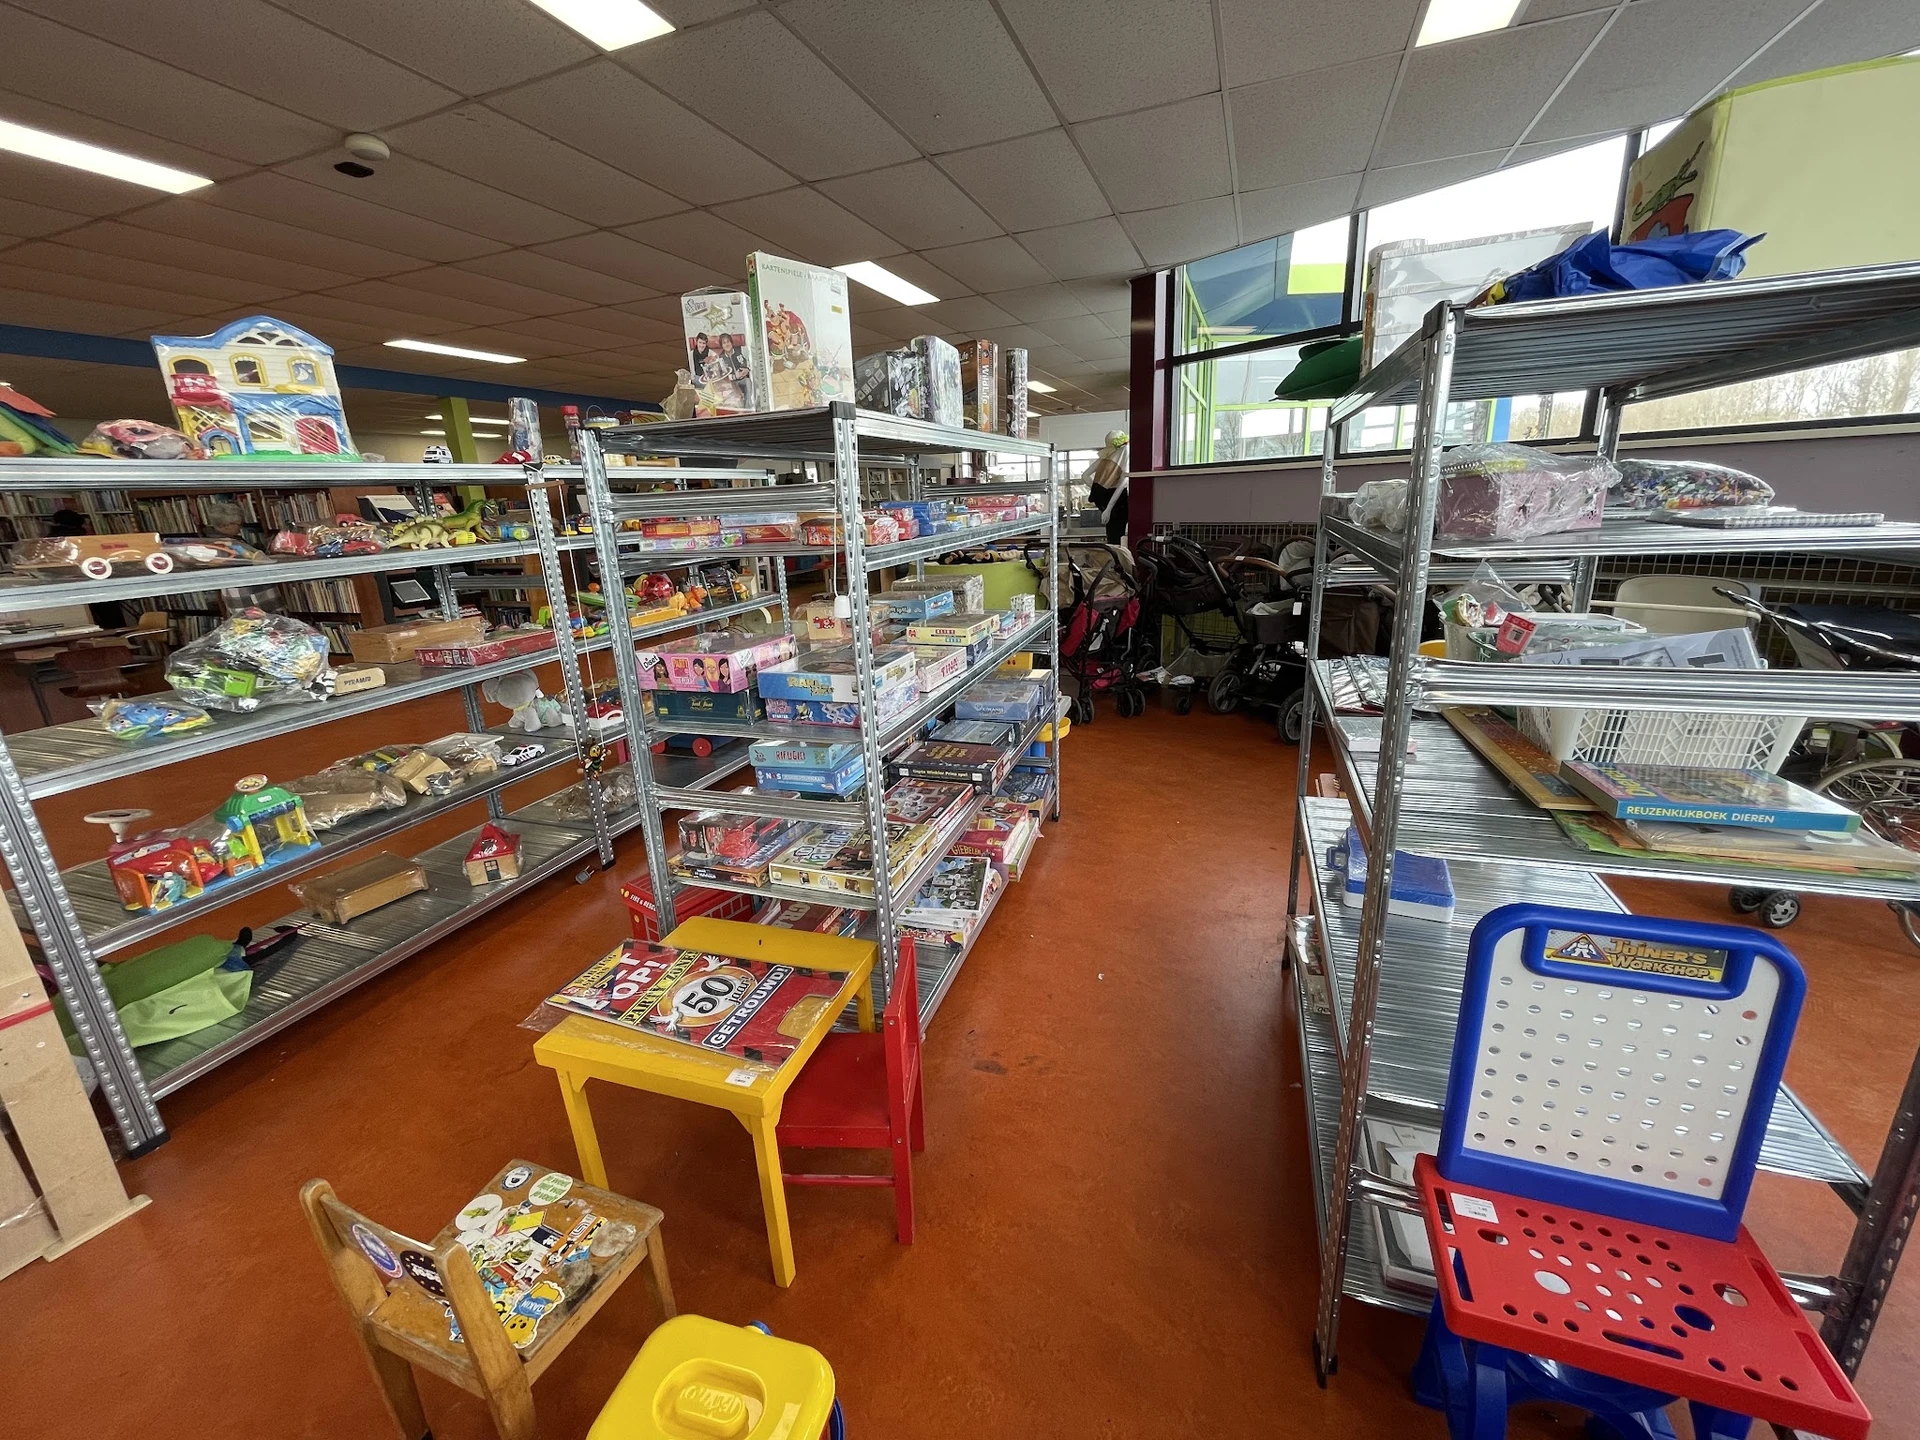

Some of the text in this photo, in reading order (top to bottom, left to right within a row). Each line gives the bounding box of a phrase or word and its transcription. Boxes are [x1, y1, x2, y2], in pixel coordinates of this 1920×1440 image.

[343, 675, 372, 686] PYRAMID
[1626, 805, 1775, 824] REUZENKIJKBOEK DIEREN
[612, 960, 668, 1000] OP!
[681, 976, 735, 1015] 50
[725, 974, 756, 1005] jaar!
[624, 985, 665, 1024] PARTY
[709, 966, 790, 1045] GETROUWD!
